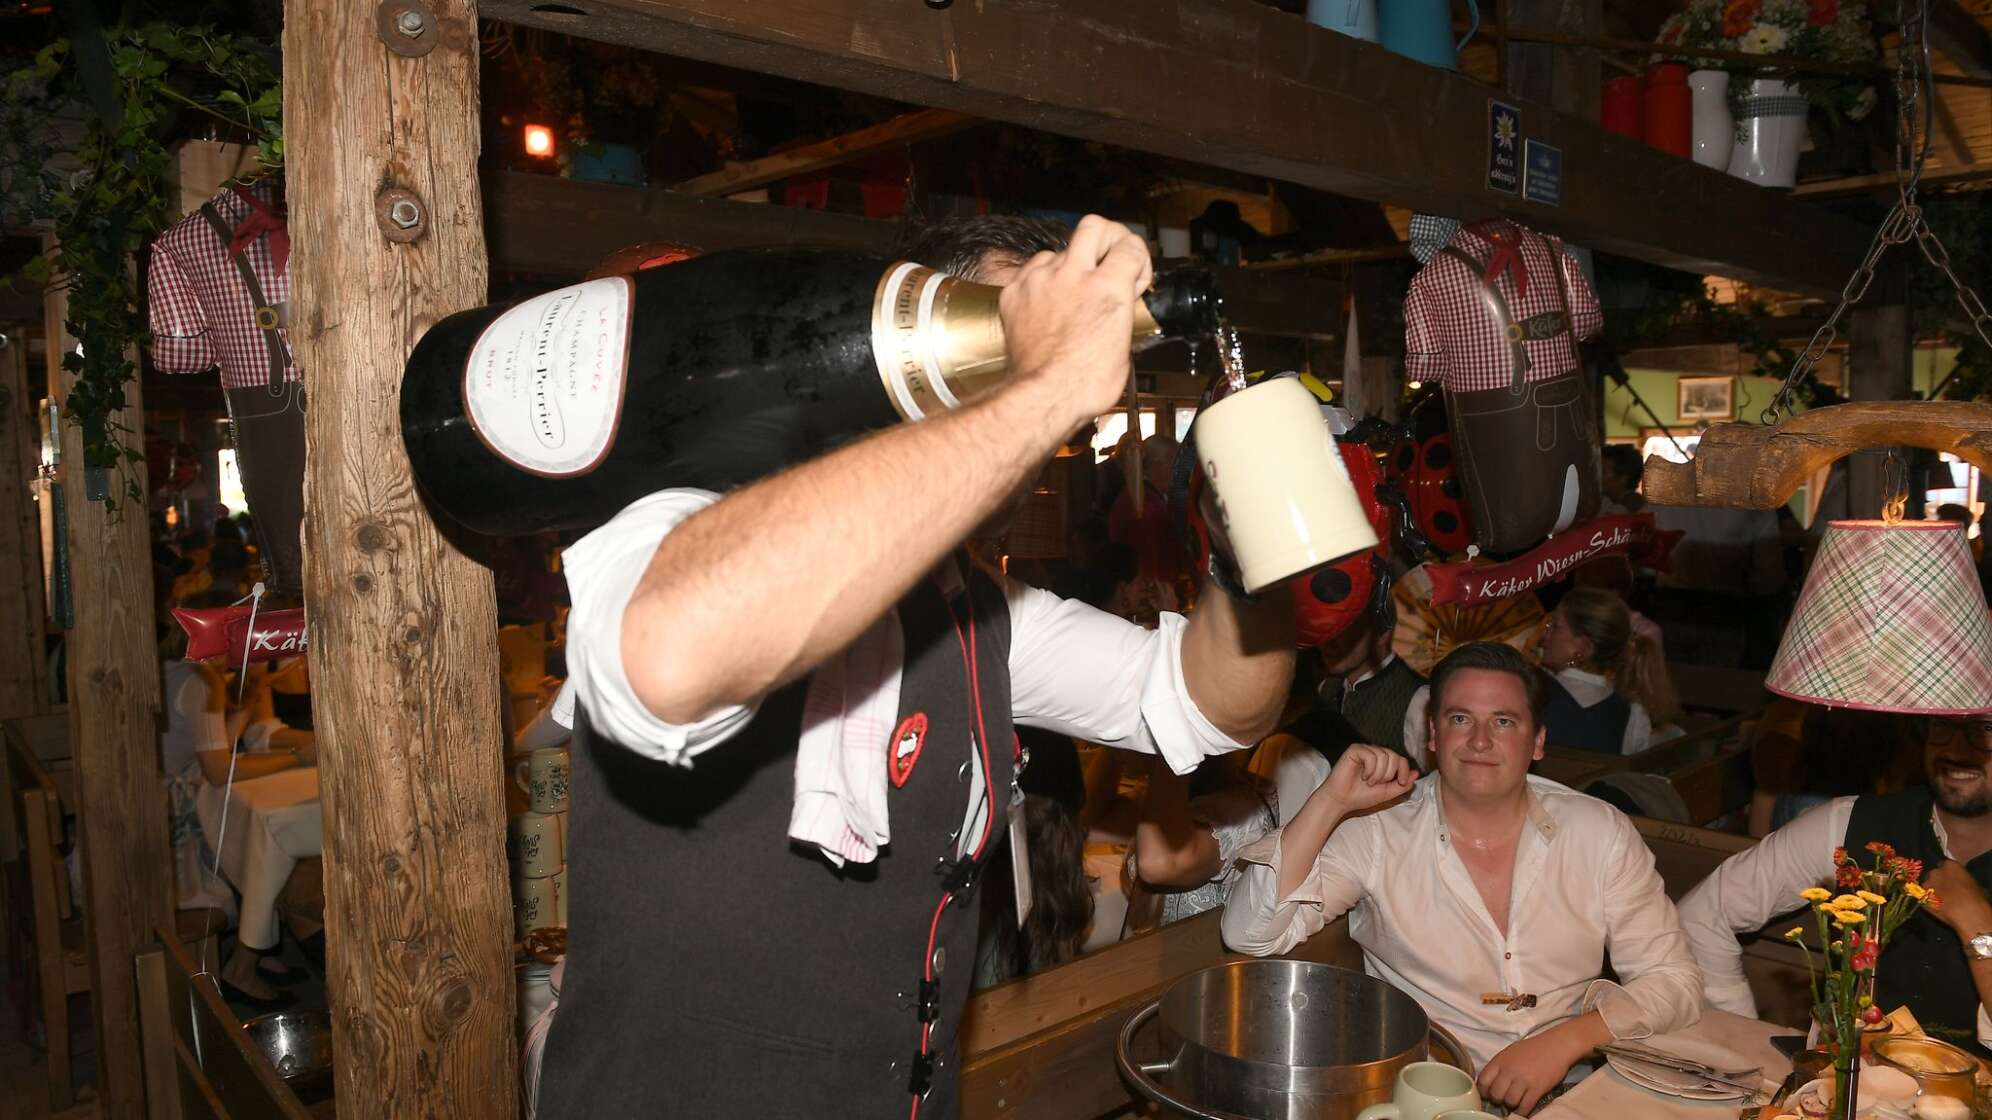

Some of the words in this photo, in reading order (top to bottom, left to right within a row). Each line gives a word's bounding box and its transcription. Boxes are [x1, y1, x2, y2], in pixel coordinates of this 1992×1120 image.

[536, 294, 574, 440] Laurent-Perrier
[568, 309, 588, 400] CHAMPAGNE
[1479, 577, 1533, 599] Käfer
